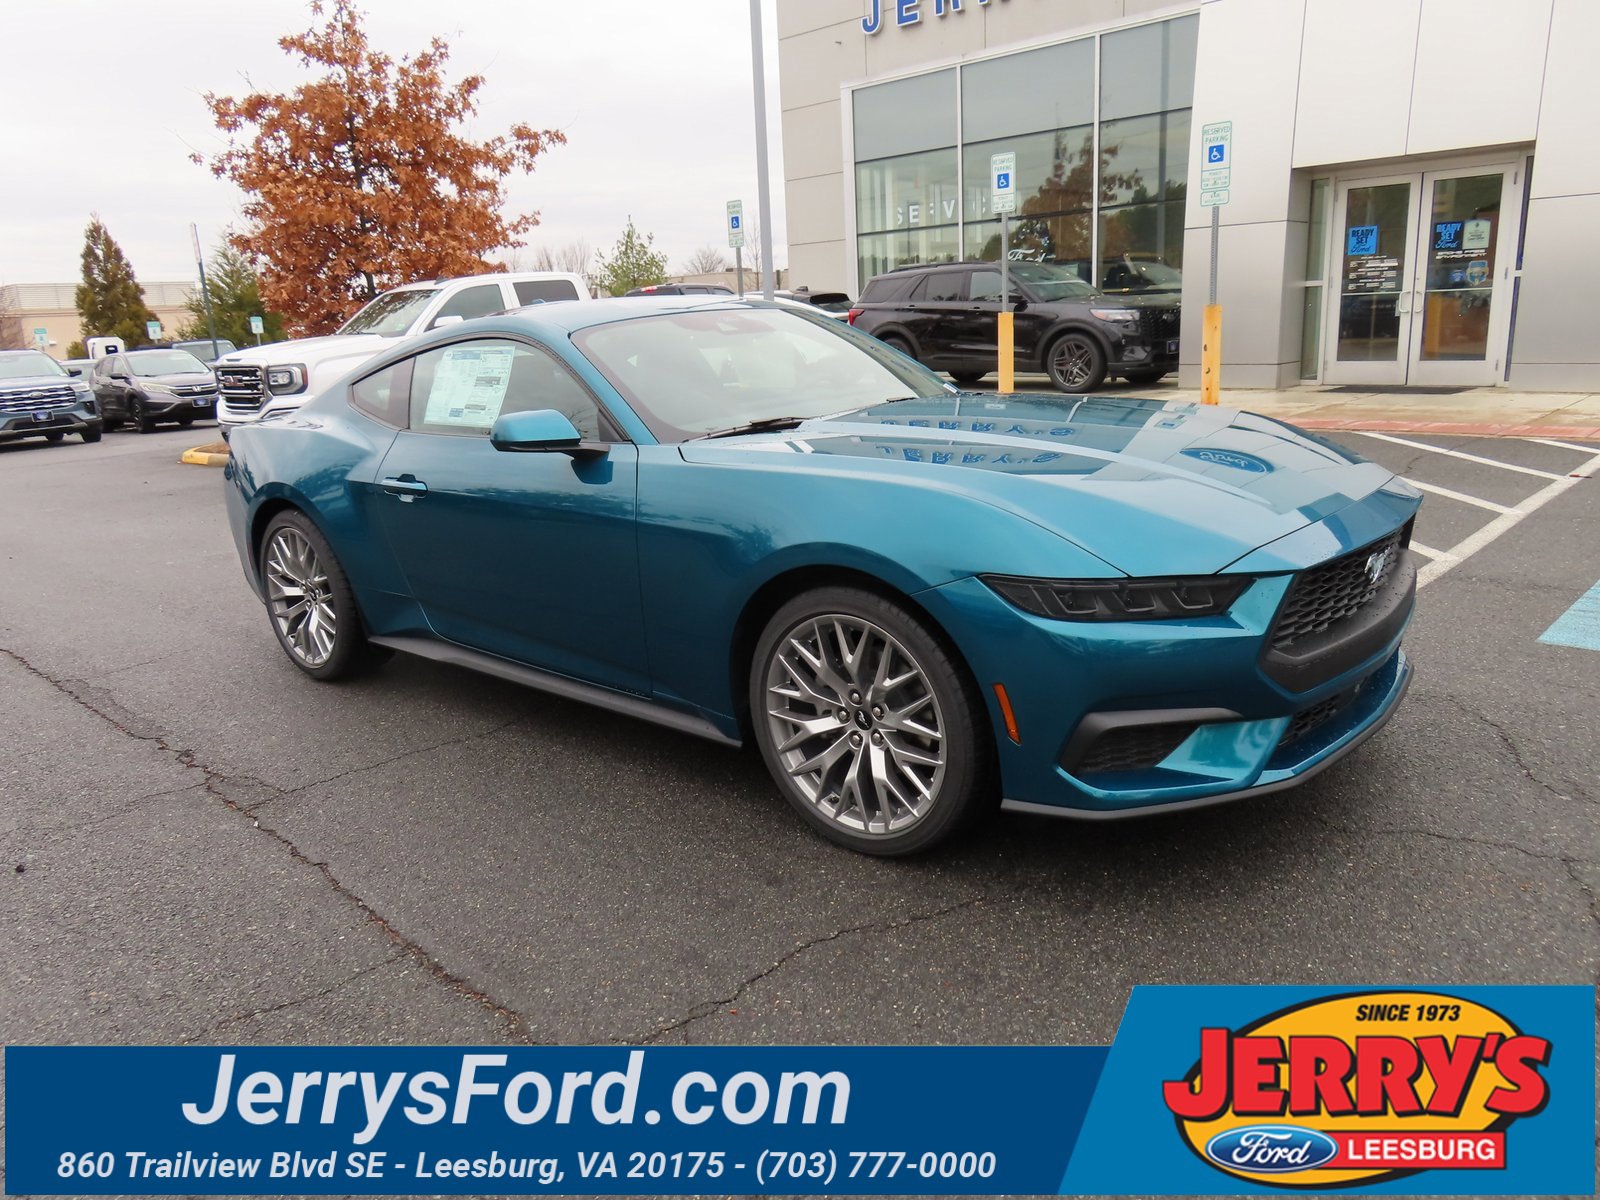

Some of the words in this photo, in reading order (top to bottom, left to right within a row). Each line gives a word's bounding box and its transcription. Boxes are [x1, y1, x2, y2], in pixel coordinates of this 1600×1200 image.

[861, 0, 989, 35] JE
[1436, 223, 1462, 233] READY
[1351, 229, 1375, 238] READY
[1441, 231, 1455, 241] SET
[1435, 240, 1459, 249] Ford
